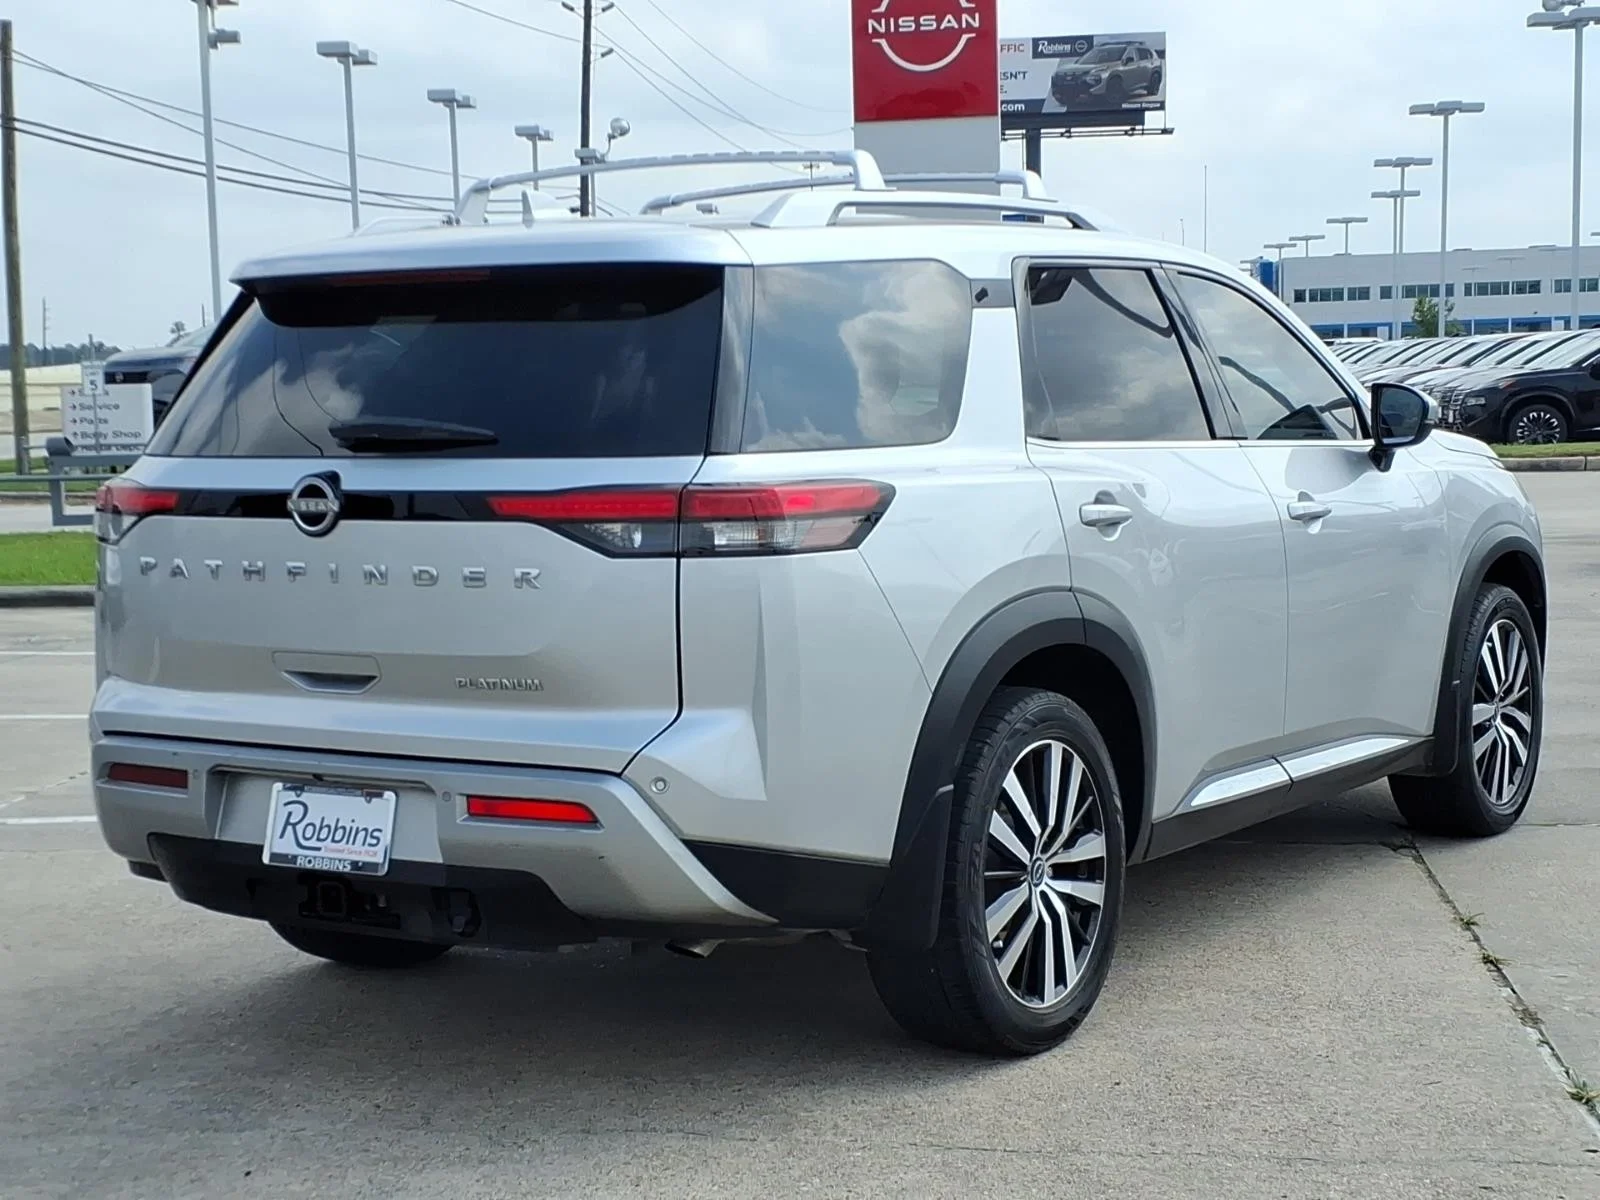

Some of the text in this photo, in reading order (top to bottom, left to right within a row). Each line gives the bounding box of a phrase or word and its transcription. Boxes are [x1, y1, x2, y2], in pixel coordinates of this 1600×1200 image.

[868, 12, 980, 34] NISSAN
[89, 379, 98, 391] 5
[78, 402, 120, 411] Sevice
[79, 417, 109, 425] Pats
[112, 430, 142, 440] Shop
[139, 556, 542, 590] PATHFINDER
[455, 677, 544, 692] PLATINUM
[279, 800, 383, 852] Robbins
[296, 855, 352, 872] ROBBINS
